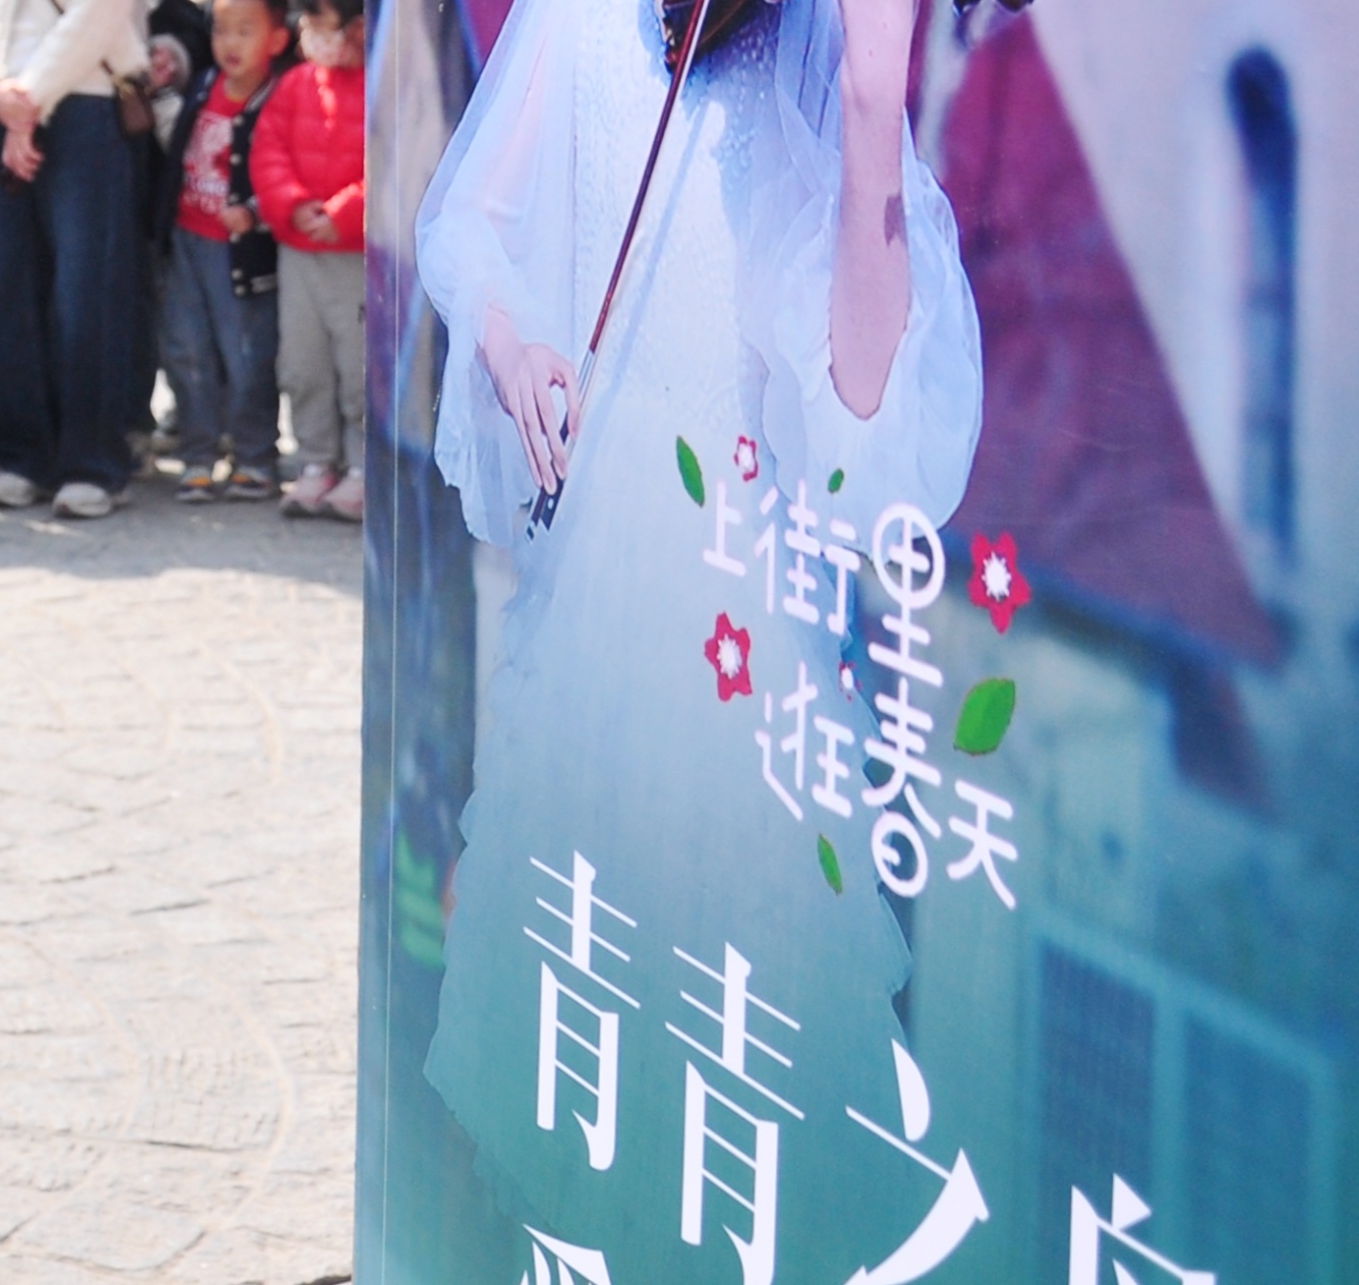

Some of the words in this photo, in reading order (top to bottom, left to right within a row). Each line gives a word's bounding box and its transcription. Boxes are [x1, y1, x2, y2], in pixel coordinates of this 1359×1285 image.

[702, 479, 945, 686] 上街里
[754, 660, 1019, 910] 逛春天
